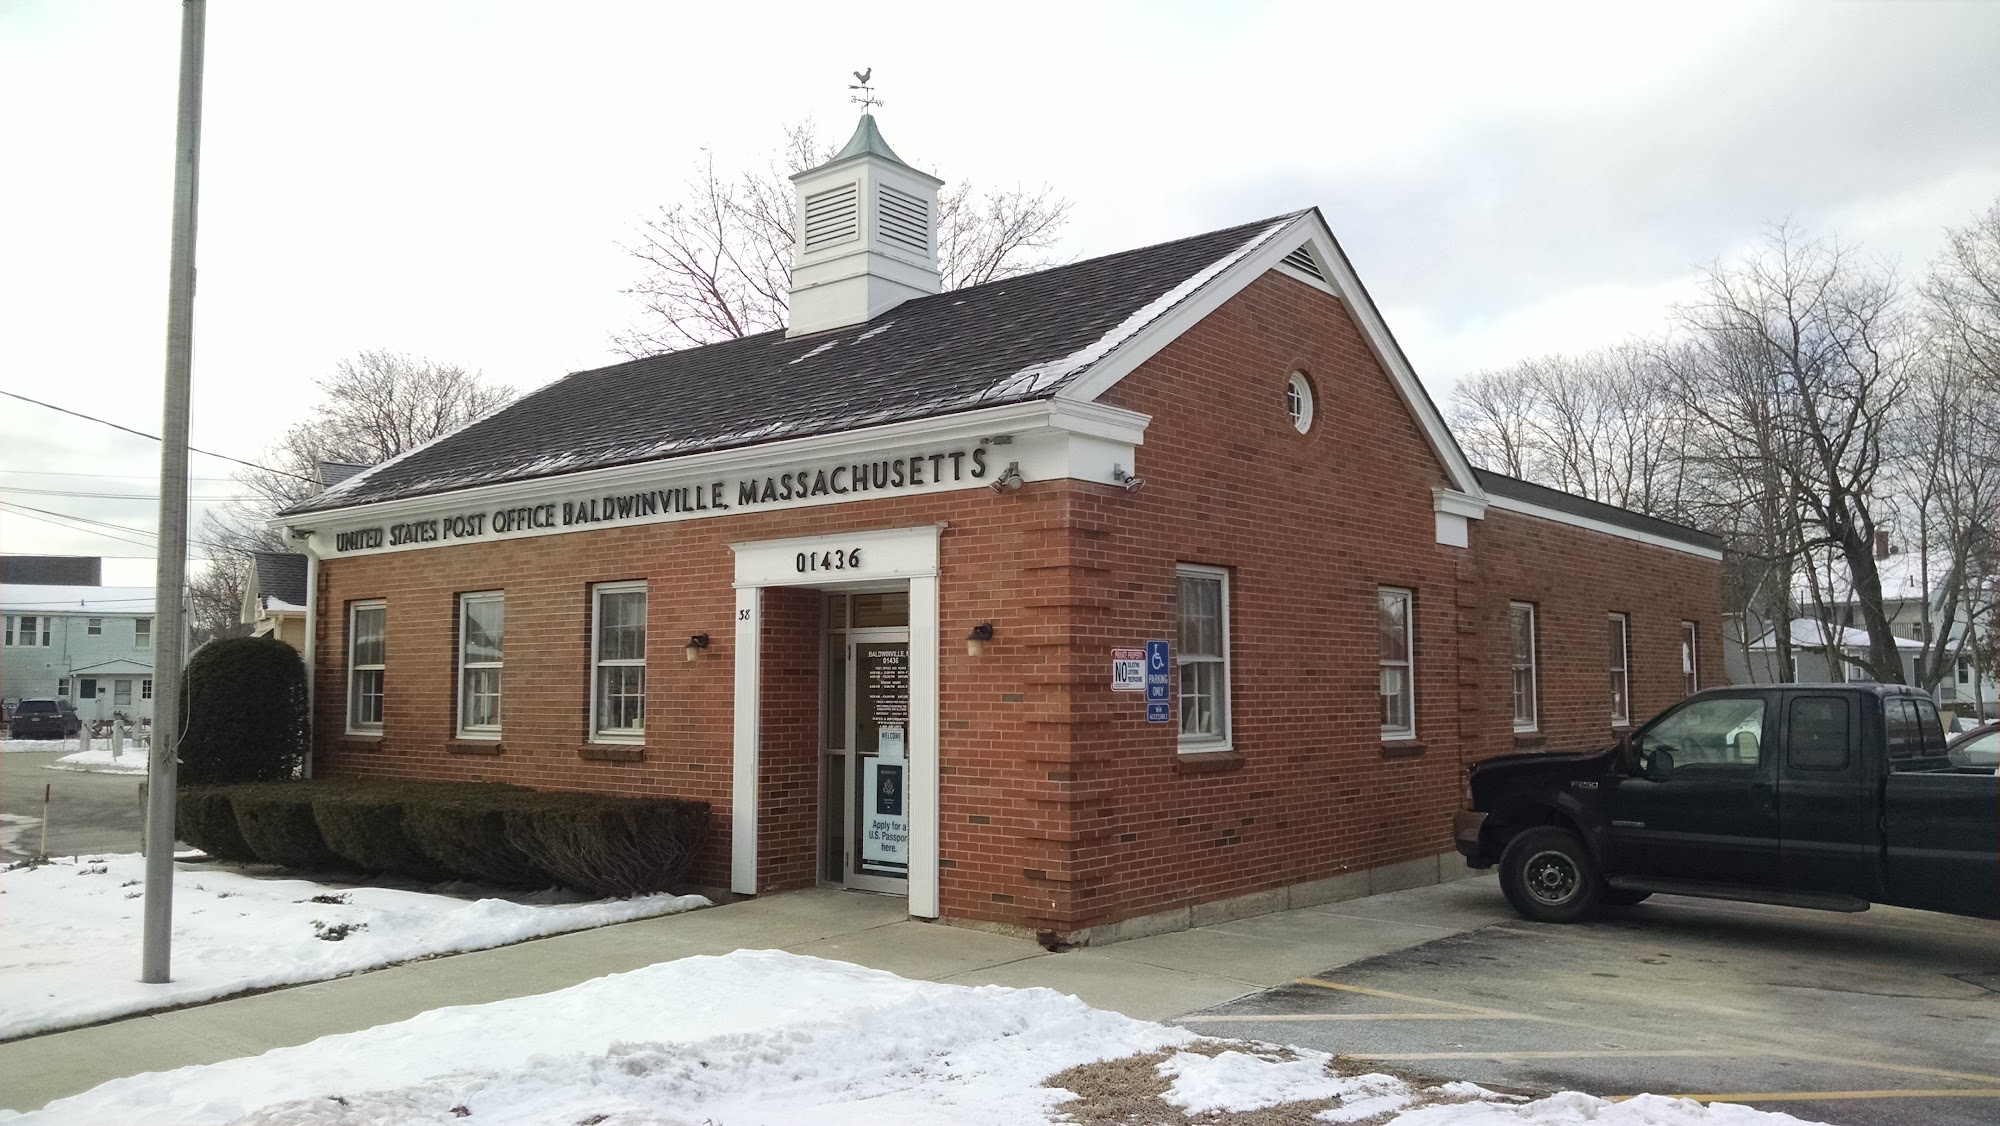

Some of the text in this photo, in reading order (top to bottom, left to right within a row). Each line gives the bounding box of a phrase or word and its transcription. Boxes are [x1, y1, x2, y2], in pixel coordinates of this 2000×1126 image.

[336, 448, 987, 552] UNITED STATES POST OFFICE BALDWINVILLE, MASSACHUSETTS
[796, 548, 862, 573] 01436
[738, 609, 751, 621] 38
[1115, 662, 1127, 682] NO
[1149, 674, 1168, 684] PARKING
[1152, 686, 1164, 696] ONLY
[881, 731, 902, 739] WELCOME
[873, 820, 890, 831] Apply
[892, 821, 901, 831] for
[869, 831, 908, 843] U.S. Passpor
[881, 842, 897, 853] here.
